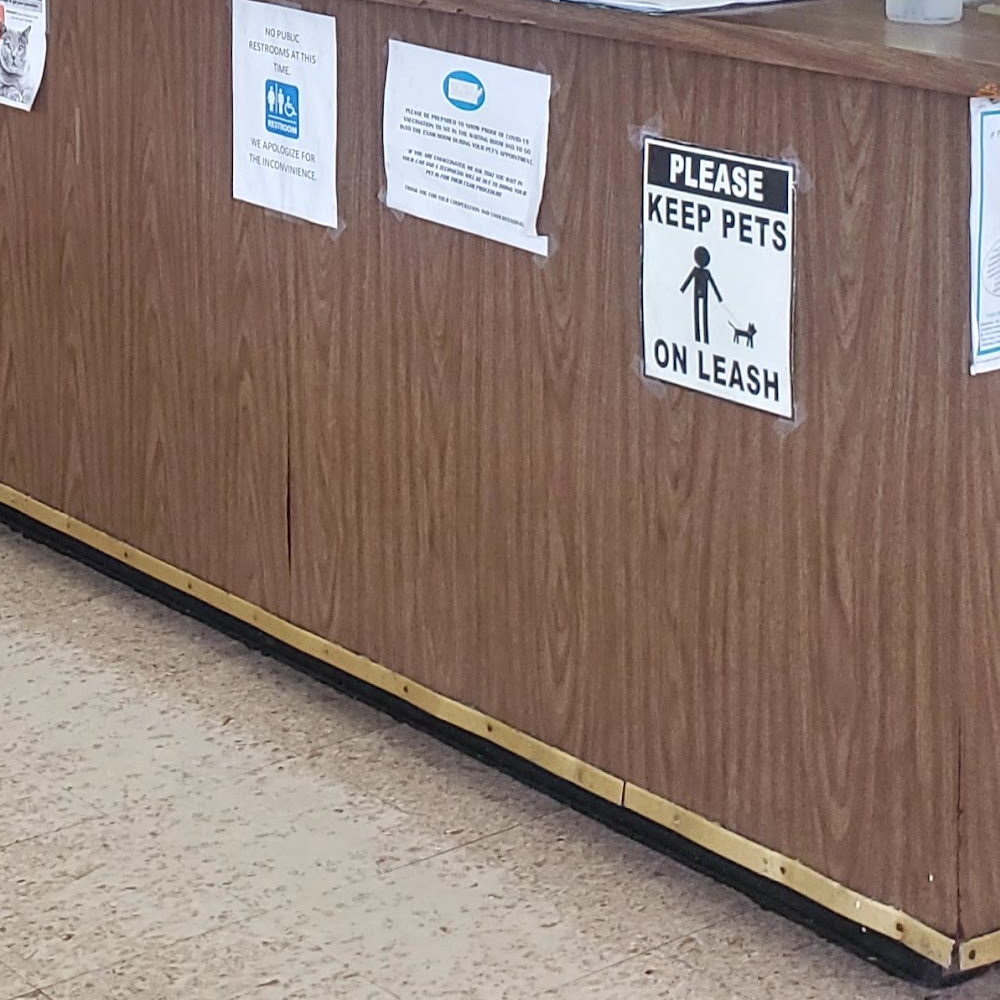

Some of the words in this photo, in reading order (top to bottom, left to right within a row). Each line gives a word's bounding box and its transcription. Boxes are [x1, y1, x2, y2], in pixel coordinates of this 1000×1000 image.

[265, 27, 275, 38] NO
[276, 30, 300, 44] PUBLIC
[249, 41, 290, 59] RESTROOMS
[291, 50, 300, 60] AT
[301, 52, 316, 64] THIS
[274, 62, 291, 76] TIME.
[267, 119, 298, 135] RESTROOM
[431, 114, 456, 126] PREPARED
[437, 133, 451, 142] ROOM
[490, 138, 504, 147] ROOM
[251, 137, 261, 148] WE
[263, 141, 300, 160] APOLOGIZE
[302, 152, 316, 163] FOR
[249, 154, 261, 165] THE
[670, 152, 764, 202] PLEASE
[648, 192, 711, 233] KEEP
[722, 209, 787, 252] PETS
[654, 338, 688, 376] ON
[698, 350, 780, 402] LEASH
